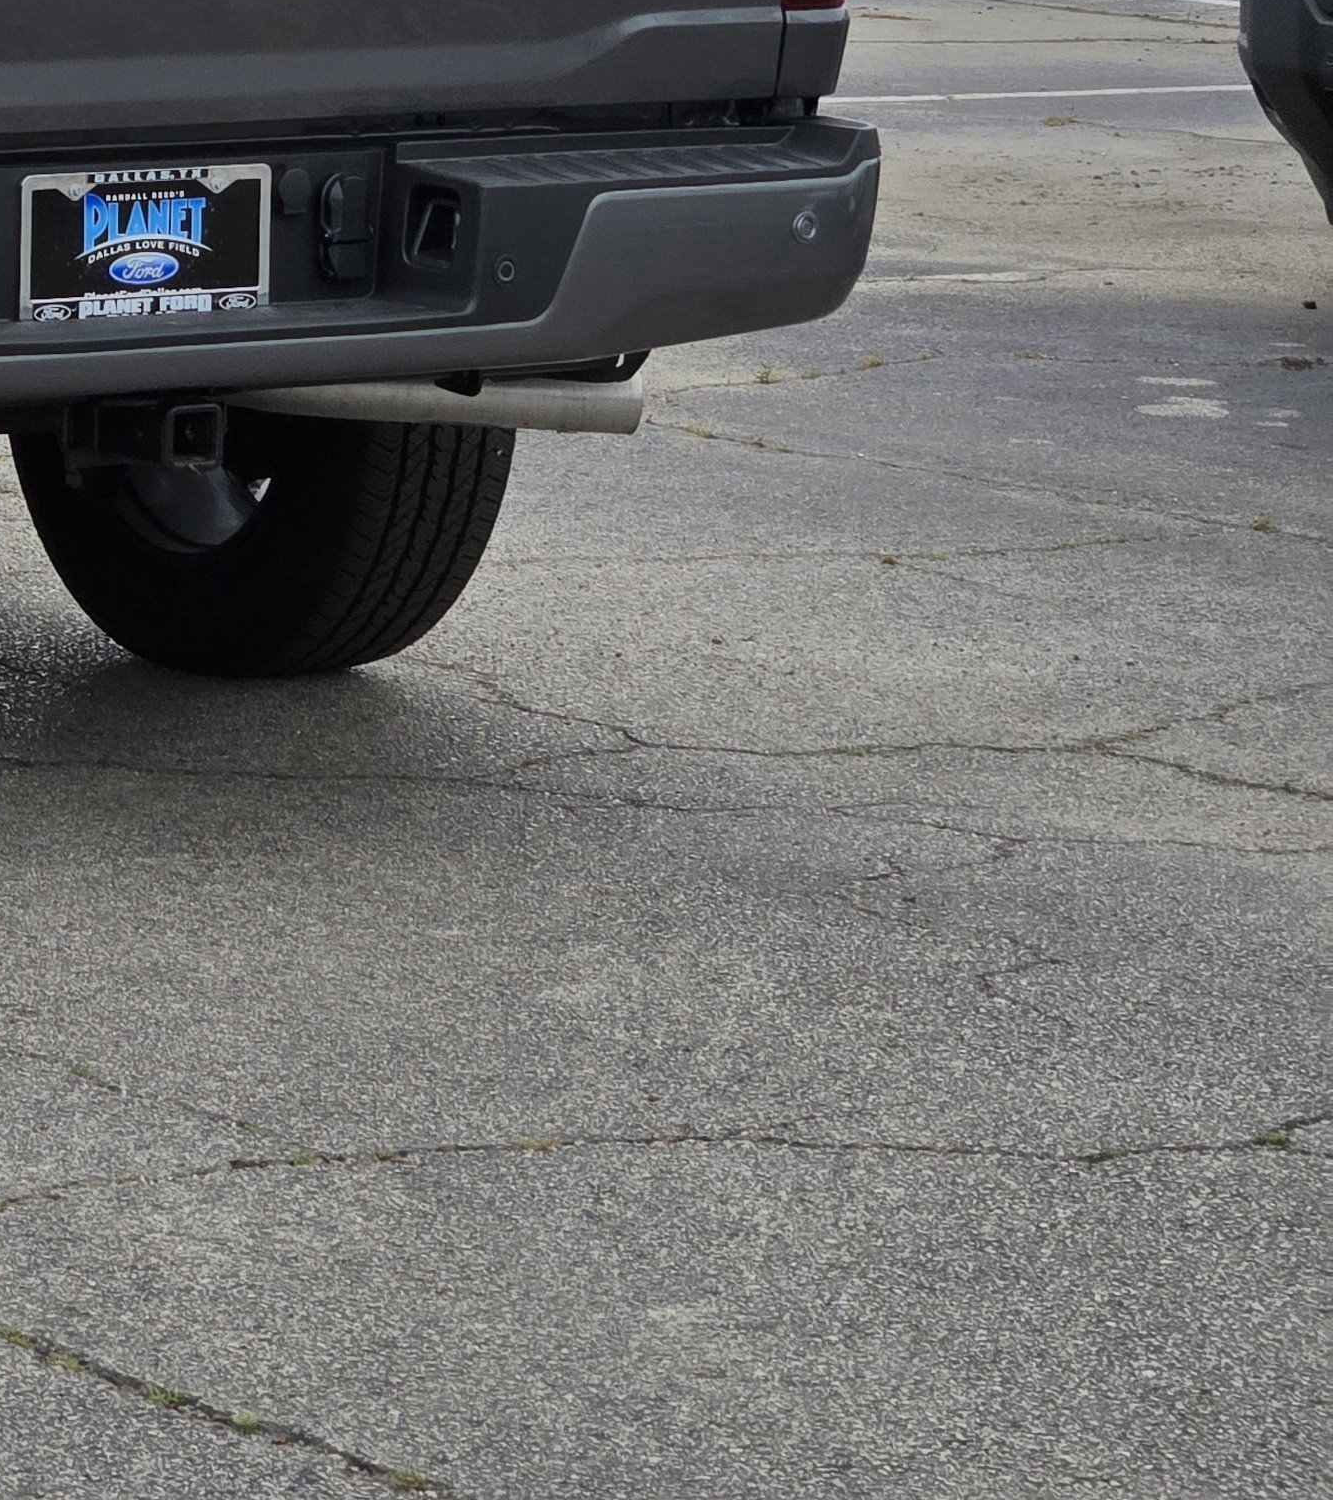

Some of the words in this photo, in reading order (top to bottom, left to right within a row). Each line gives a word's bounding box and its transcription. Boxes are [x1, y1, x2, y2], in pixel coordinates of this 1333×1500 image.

[105, 192, 148, 202] RANDALL
[152, 190, 185, 200] REED'S
[84, 193, 206, 252] PLANET
[88, 243, 131, 264] DALLAS
[135, 241, 165, 250] LOVE
[168, 242, 200, 257] FIELD
[122, 258, 165, 279] Ford
[78, 298, 154, 320] PLANET
[159, 294, 212, 312] FORD
